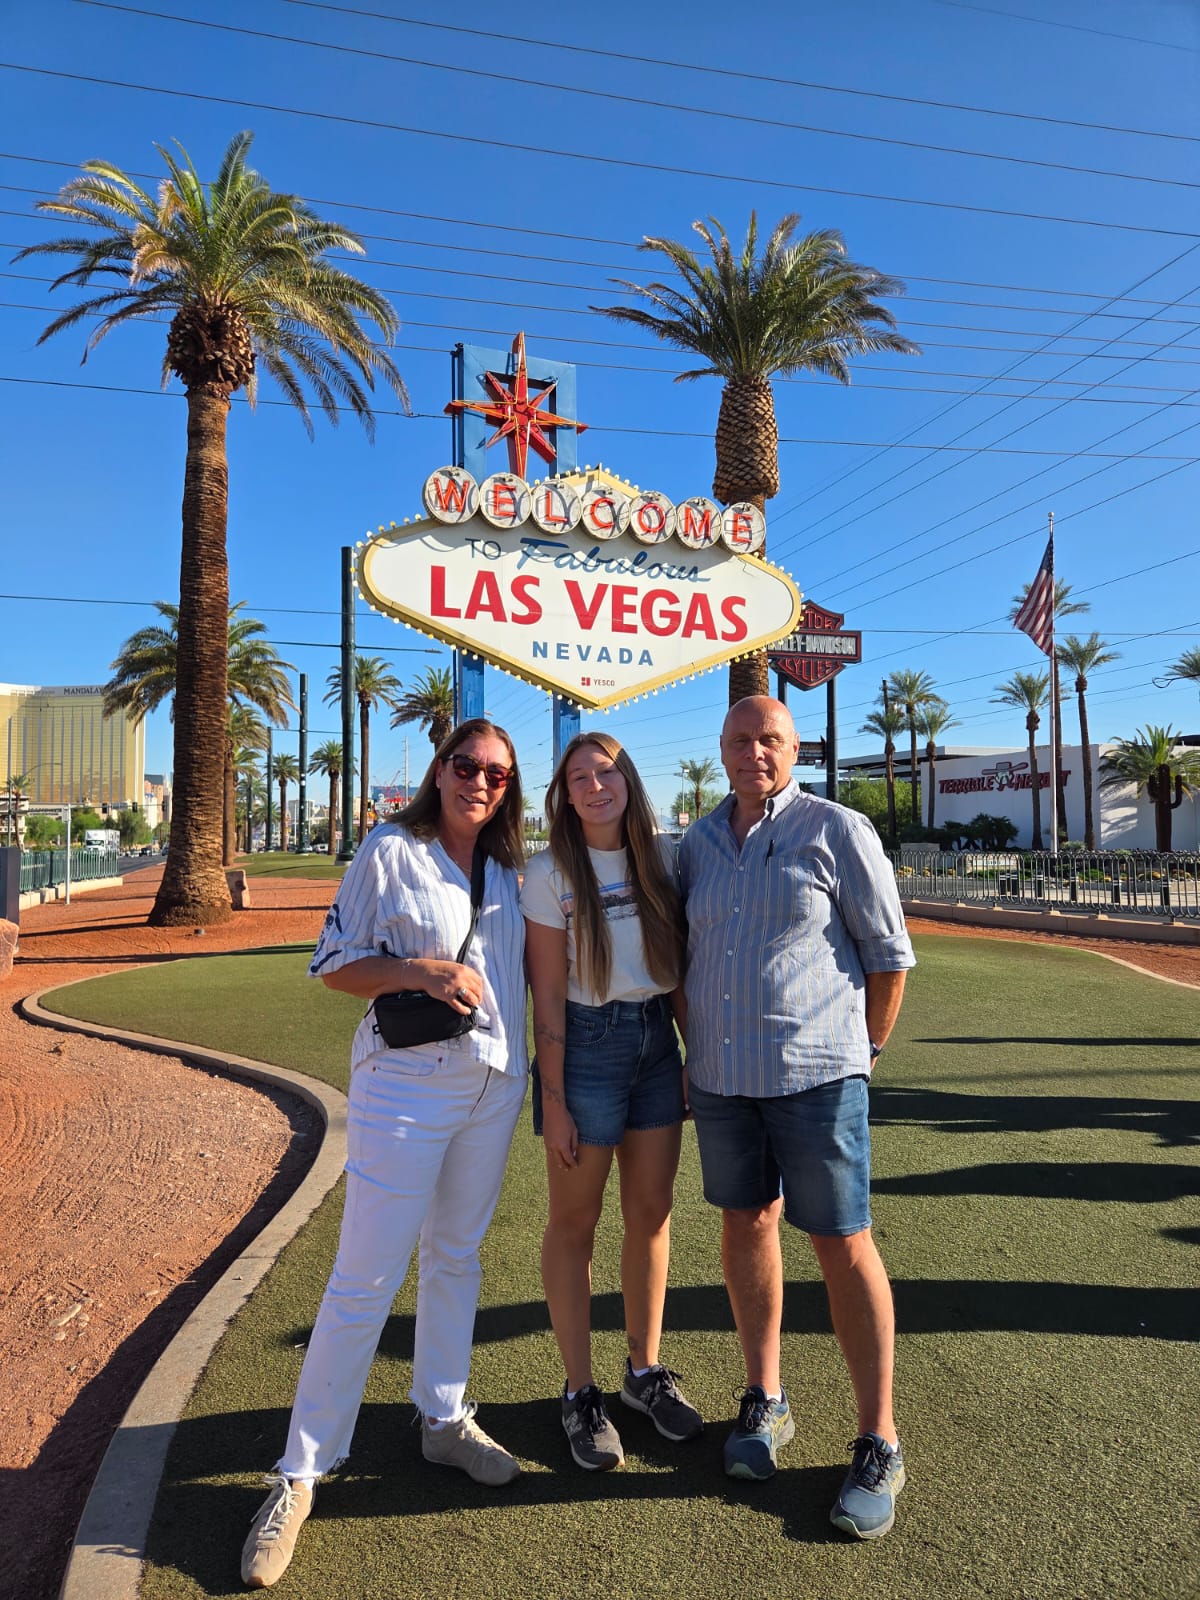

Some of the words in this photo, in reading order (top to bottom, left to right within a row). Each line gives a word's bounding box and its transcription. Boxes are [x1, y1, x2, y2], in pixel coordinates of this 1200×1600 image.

[433, 477, 753, 543] WELCOME
[464, 537, 501, 560] TO
[516, 537, 711, 582] Fabulous
[430, 565, 543, 625] LAS
[563, 579, 748, 642] VEGAS
[532, 640, 653, 666] NEVADA
[593, 678, 616, 687] YESCO
